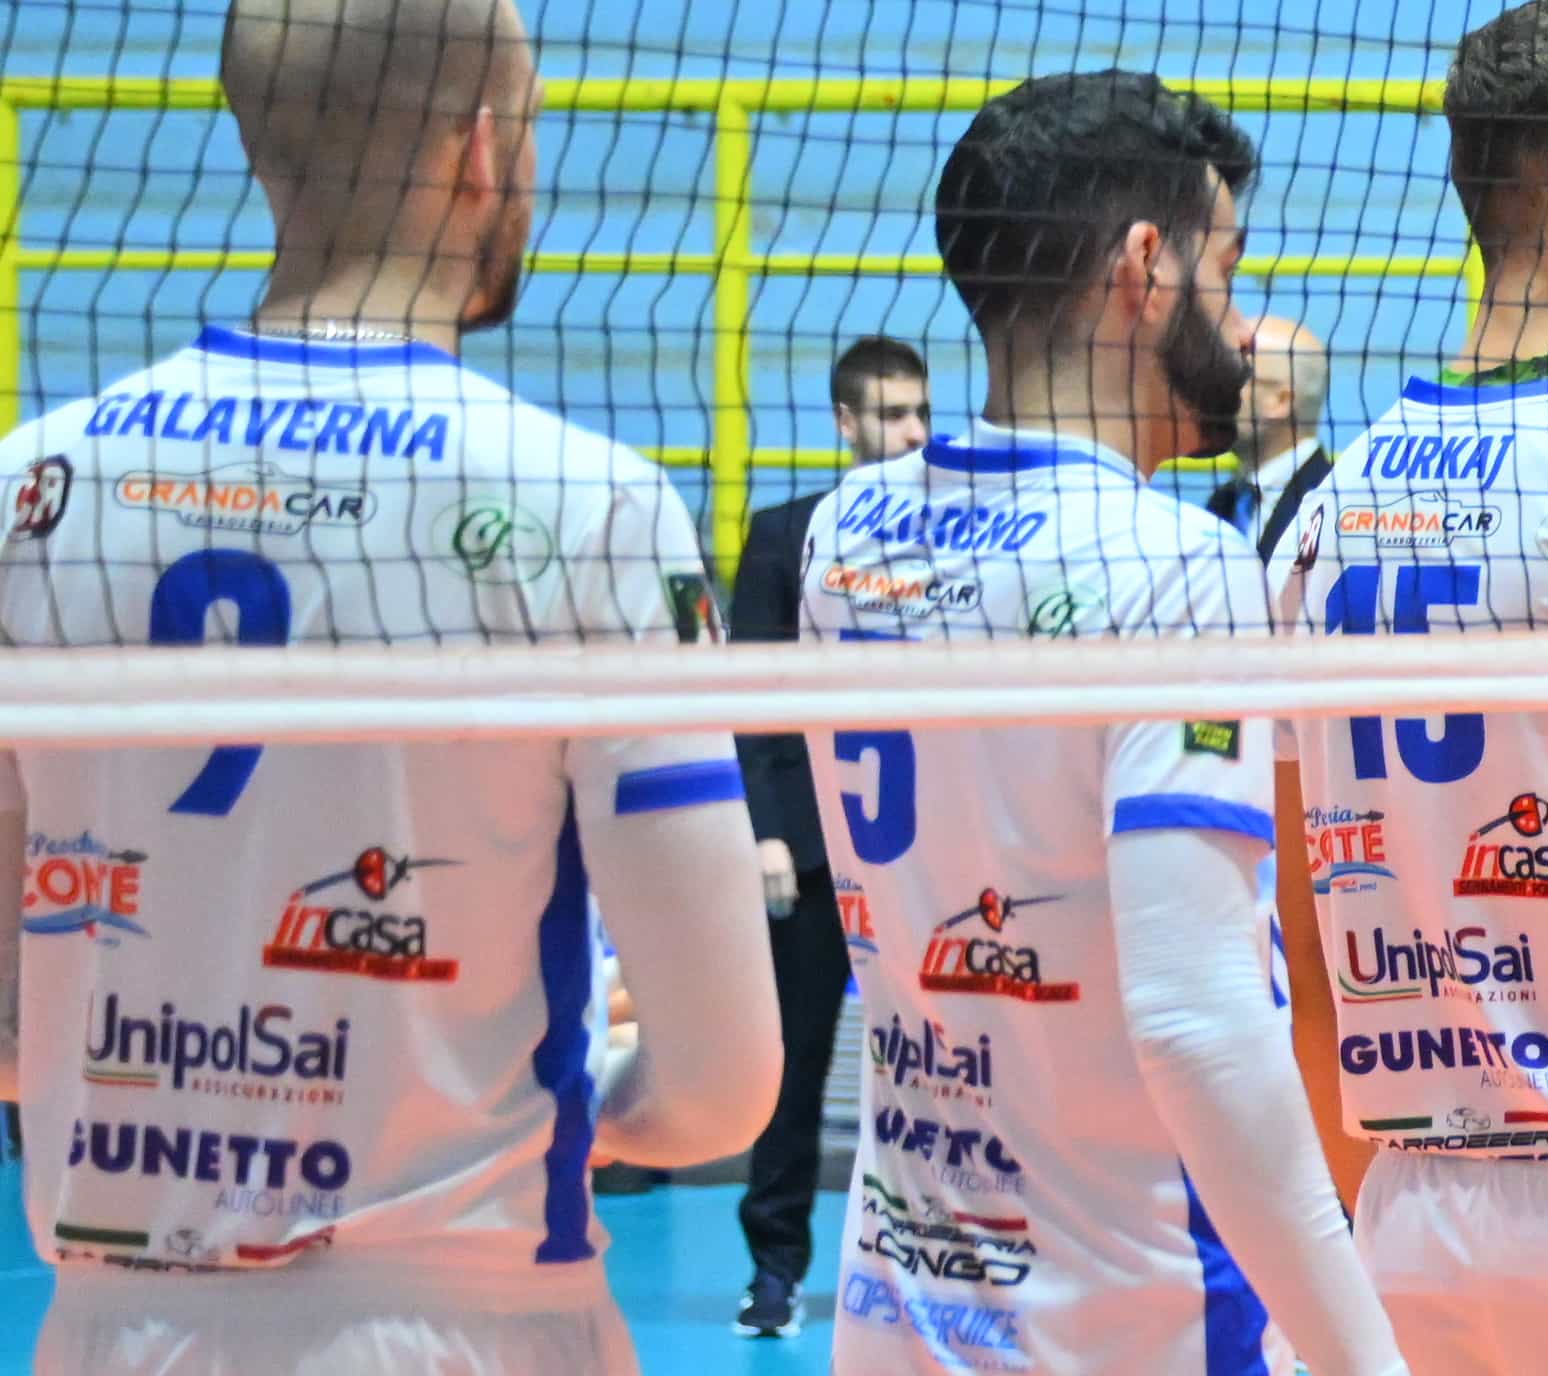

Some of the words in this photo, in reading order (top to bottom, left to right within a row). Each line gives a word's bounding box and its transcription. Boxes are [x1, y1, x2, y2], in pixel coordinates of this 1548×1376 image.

[84, 389, 450, 462] GALAVERNA
[1361, 433, 1516, 491] TURKAJ
[121, 479, 364, 520] GRANDACAR
[1339, 511, 1494, 532] GRANDACAR
[1325, 564, 1486, 784] 15
[272, 890, 426, 960] incasa
[921, 925, 1041, 984] incasa
[1345, 926, 1534, 997] UnipolSai
[88, 990, 350, 1089] UnipolSai
